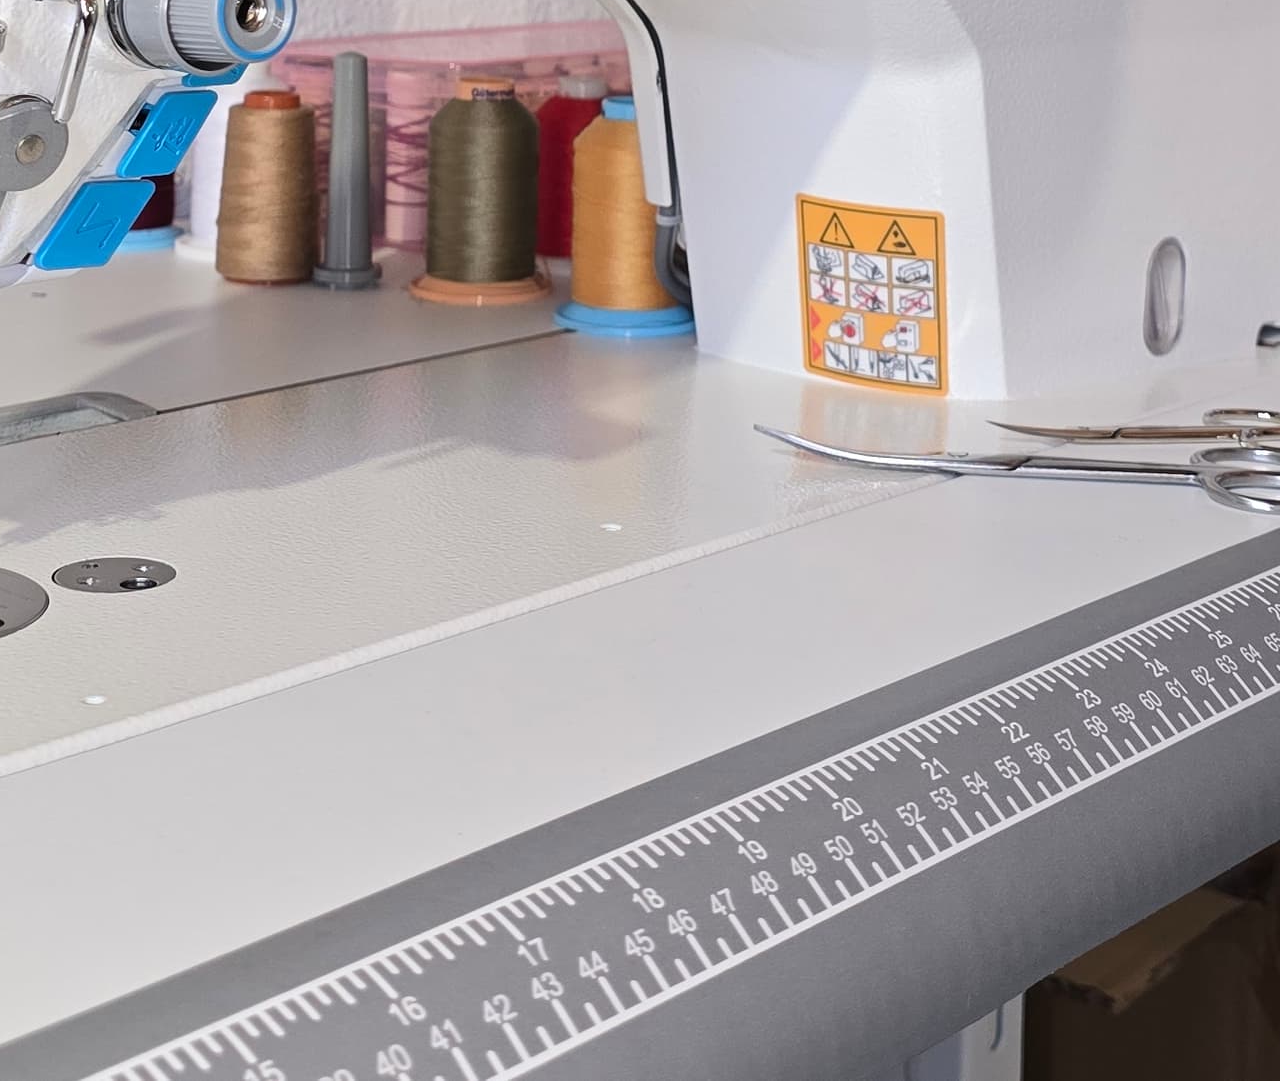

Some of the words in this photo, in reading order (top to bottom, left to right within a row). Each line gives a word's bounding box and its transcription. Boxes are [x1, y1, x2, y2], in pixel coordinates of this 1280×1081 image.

[377, 1044, 412, 1075] 40
[431, 1019, 462, 1049] 41
[484, 995, 518, 1023] 42
[532, 973, 564, 1000] 43
[579, 951, 608, 979] 44
[625, 929, 654, 956] 45
[668, 909, 696, 935] 46
[710, 888, 736, 915] 47
[751, 871, 778, 895] 48
[791, 853, 816, 877] 49
[824, 835, 854, 861] 50
[860, 819, 888, 843] 51
[896, 802, 926, 826] 52
[930, 787, 958, 810] 53
[962, 771, 989, 795] 54
[994, 755, 1020, 779] 55
[1025, 743, 1050, 764] 56
[1054, 728, 1076, 751] 57
[1083, 715, 1108, 737] 58
[1111, 703, 1135, 723] 59
[1138, 690, 1162, 710] 60
[1166, 678, 1188, 697] 61
[1191, 666, 1215, 685] 62
[1216, 655, 1238, 673] 63
[1240, 643, 1262, 663] 64
[389, 997, 426, 1025] 16
[518, 937, 548, 965] 17
[632, 888, 664, 913] 18
[738, 841, 768, 863] 19
[832, 797, 863, 821] 20
[920, 757, 950, 780] 21
[1001, 722, 1030, 743] 22
[1076, 689, 1102, 709] 23
[1144, 659, 1170, 677] 24
[1208, 631, 1232, 649] 25
